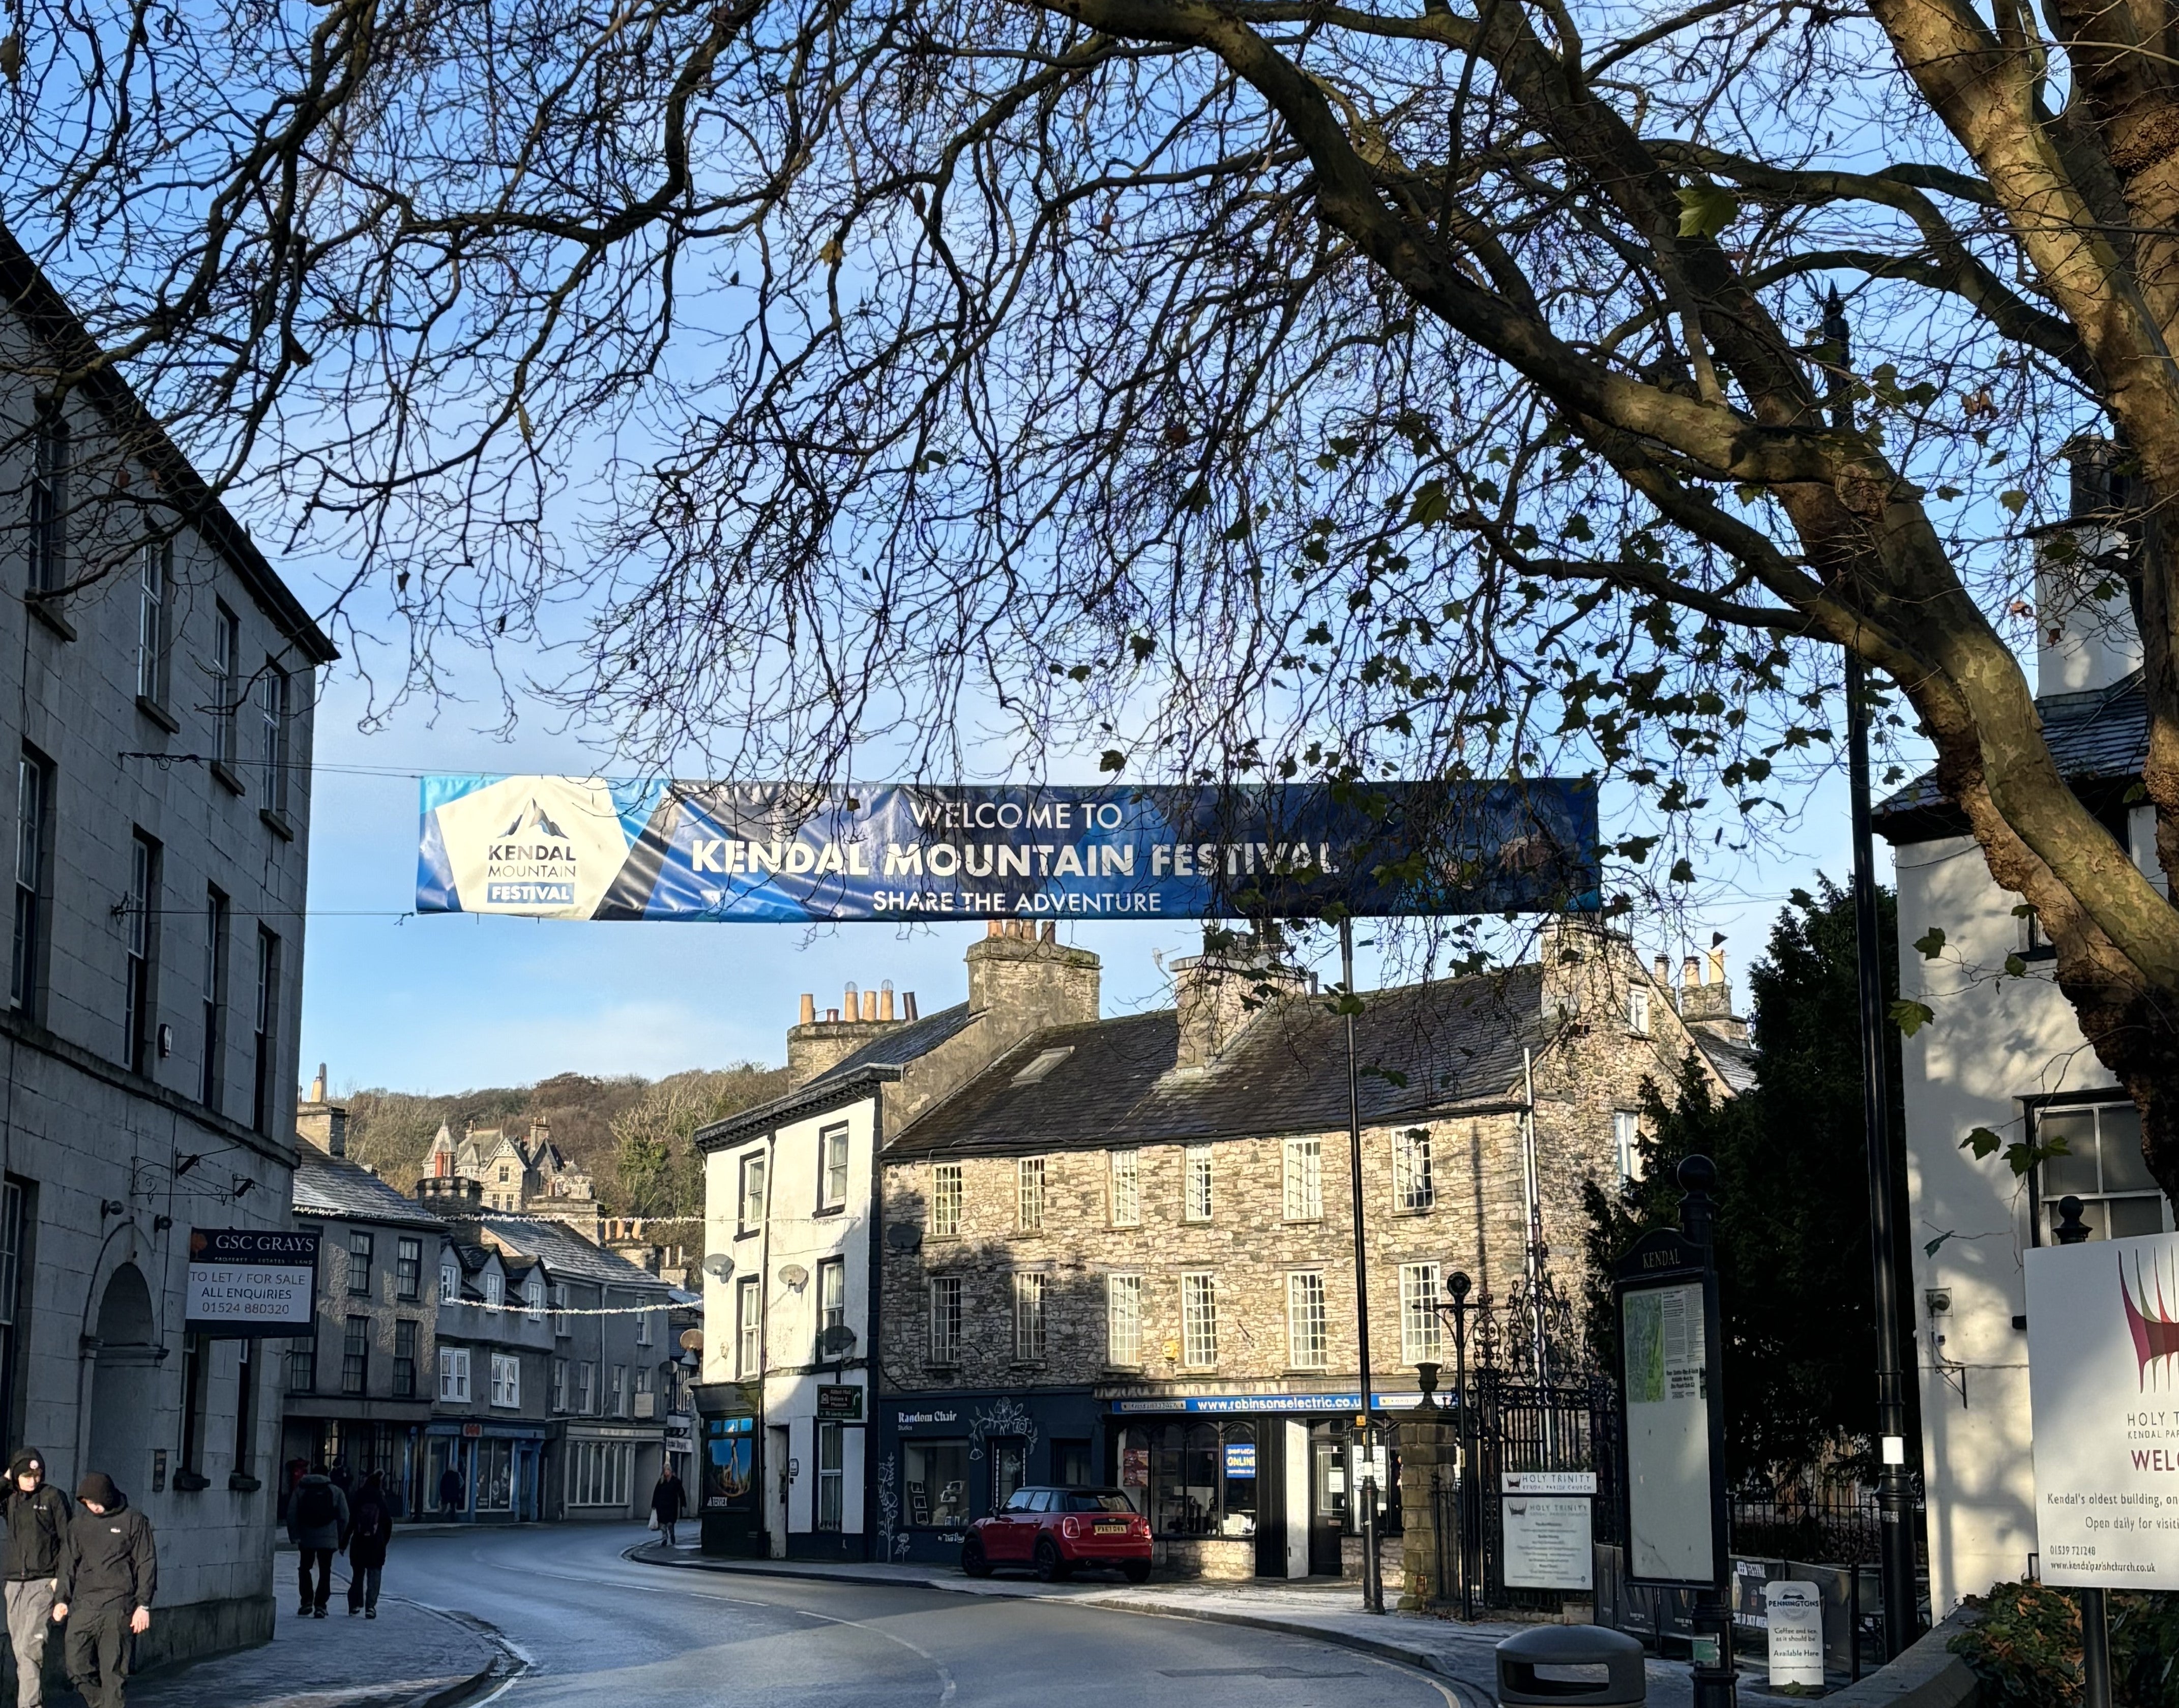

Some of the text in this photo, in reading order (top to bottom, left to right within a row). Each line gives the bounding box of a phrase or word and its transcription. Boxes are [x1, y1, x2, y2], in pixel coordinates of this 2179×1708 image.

[909, 802, 1123, 829] WELCOME TO
[488, 845, 576, 861] KENDAL
[692, 840, 1340, 876] KENDAL MOUNTAIN FESTIVAL
[488, 865, 576, 877] MOUNTAIN
[492, 885, 570, 900] FESTIVAL
[873, 890, 1161, 912] SHARE THE ADVENTURE
[216, 1235, 314, 1251] GSC GRAYS
[1642, 1248, 1681, 1269] KENDAL
[190, 1272, 208, 1282] TO
[212, 1273, 233, 1283] LET
[247, 1274, 272, 1284] FOR
[276, 1274, 306, 1285] SALE
[201, 1287, 291, 1300] ALL ENQUIRIES
[202, 1302, 289, 1314] 01524 880320
[1197, 1396, 1362, 1410] www.robinsonselectric.co.u
[898, 1410, 957, 1423] Random Chair
[2127, 1411, 2165, 1426] HOLY
[2128, 1430, 2162, 1439] KENDAL
[1522, 1475, 1591, 1483] HOLY TRINITY
[2047, 1493, 2085, 1505] Kendal's
[2089, 1493, 2118, 1505] oldest
[2121, 1492, 2162, 1508] building,
[2085, 1516, 2110, 1532] Open
[2114, 1517, 2134, 1532] daily
[2139, 1516, 2153, 1529] for
[1774, 1648, 1819, 1657] Available Here
